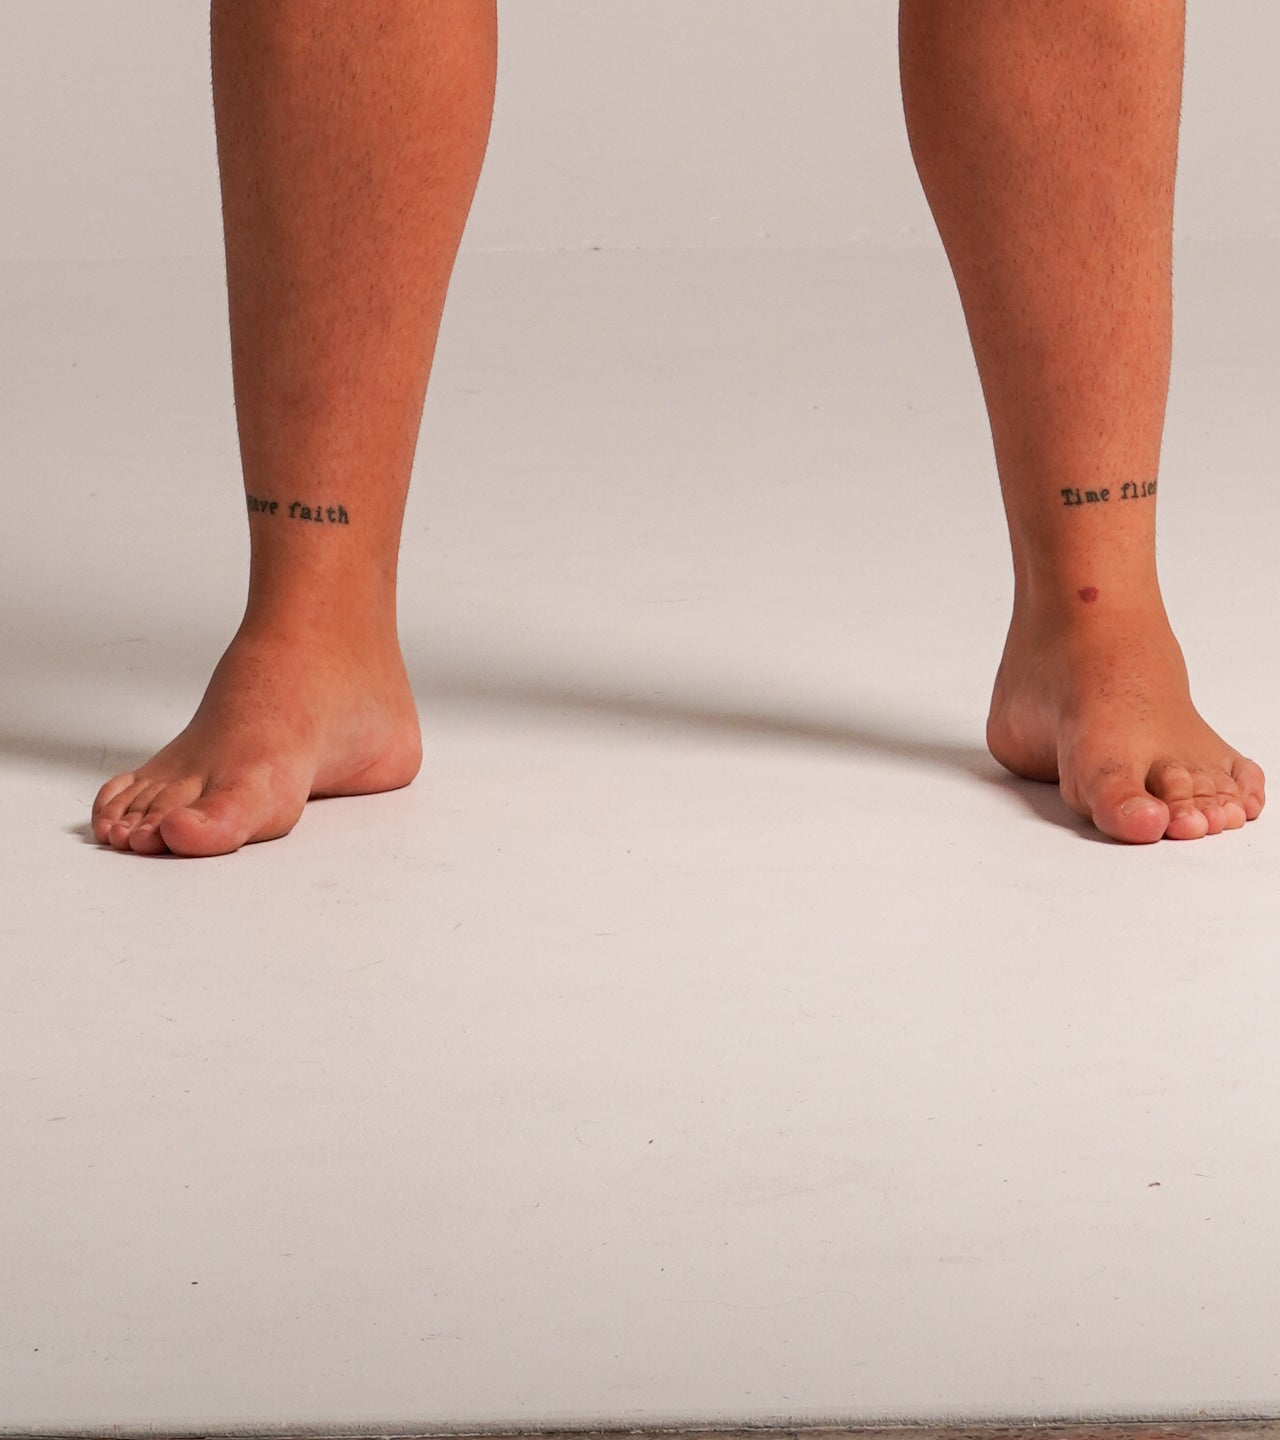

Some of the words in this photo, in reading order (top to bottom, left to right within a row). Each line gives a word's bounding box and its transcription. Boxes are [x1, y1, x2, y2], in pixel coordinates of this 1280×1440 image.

[1060, 486, 1111, 506] Time
[1120, 479, 1158, 500] flie
[287, 500, 350, 525] faith
